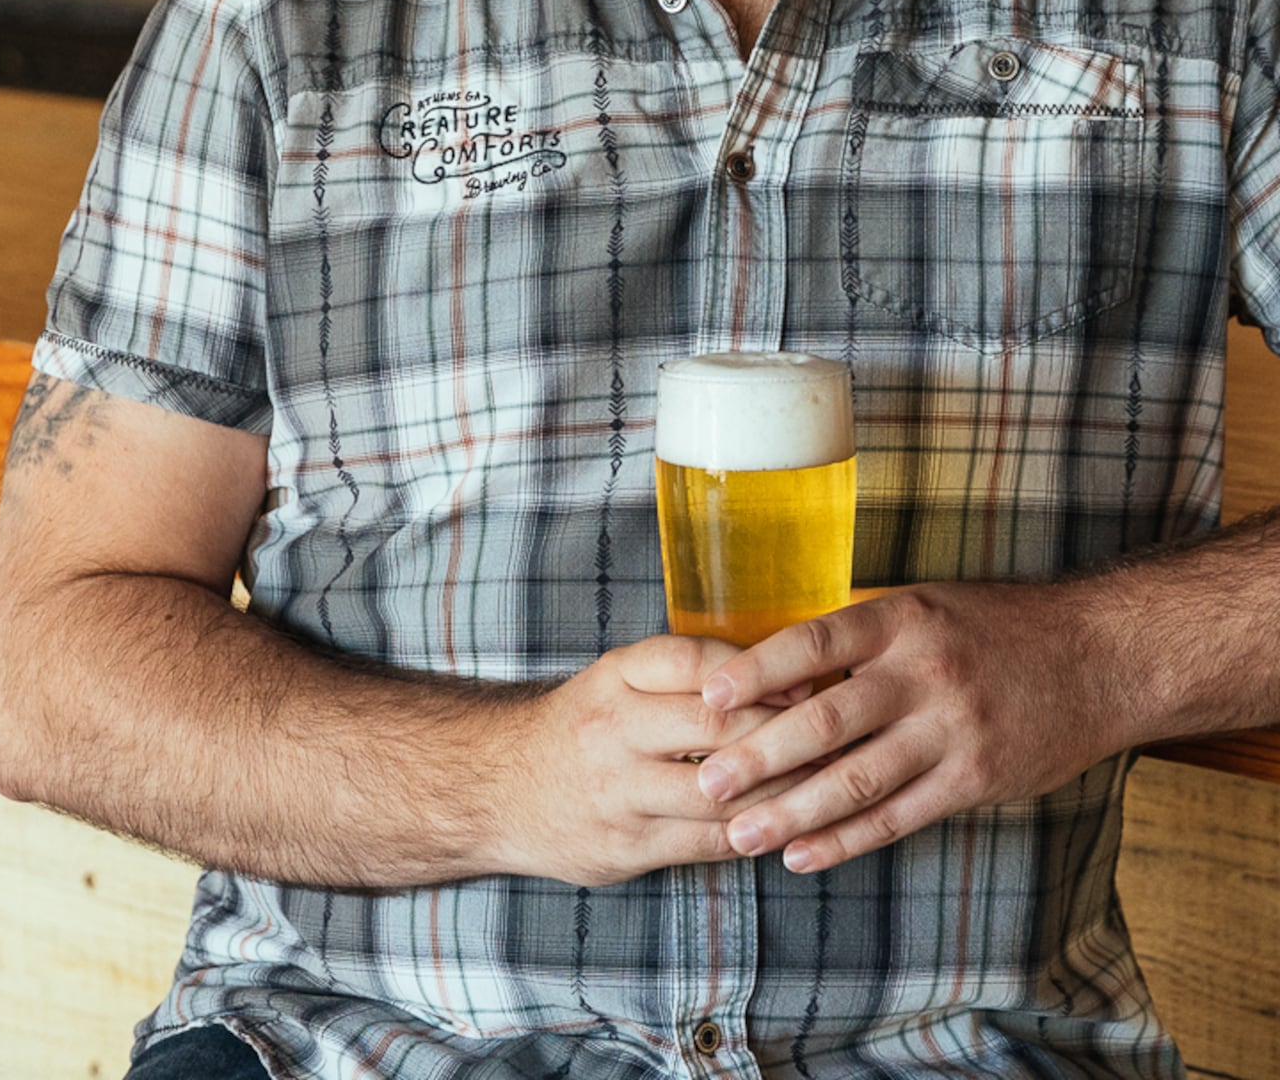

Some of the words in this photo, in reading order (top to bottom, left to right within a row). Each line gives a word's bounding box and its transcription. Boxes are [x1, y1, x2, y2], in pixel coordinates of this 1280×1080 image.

[417, 91, 461, 111] ATHENS
[378, 101, 519, 159] CREATURE
[412, 128, 562, 184] COMFORTS
[463, 171, 528, 199] Brewing
